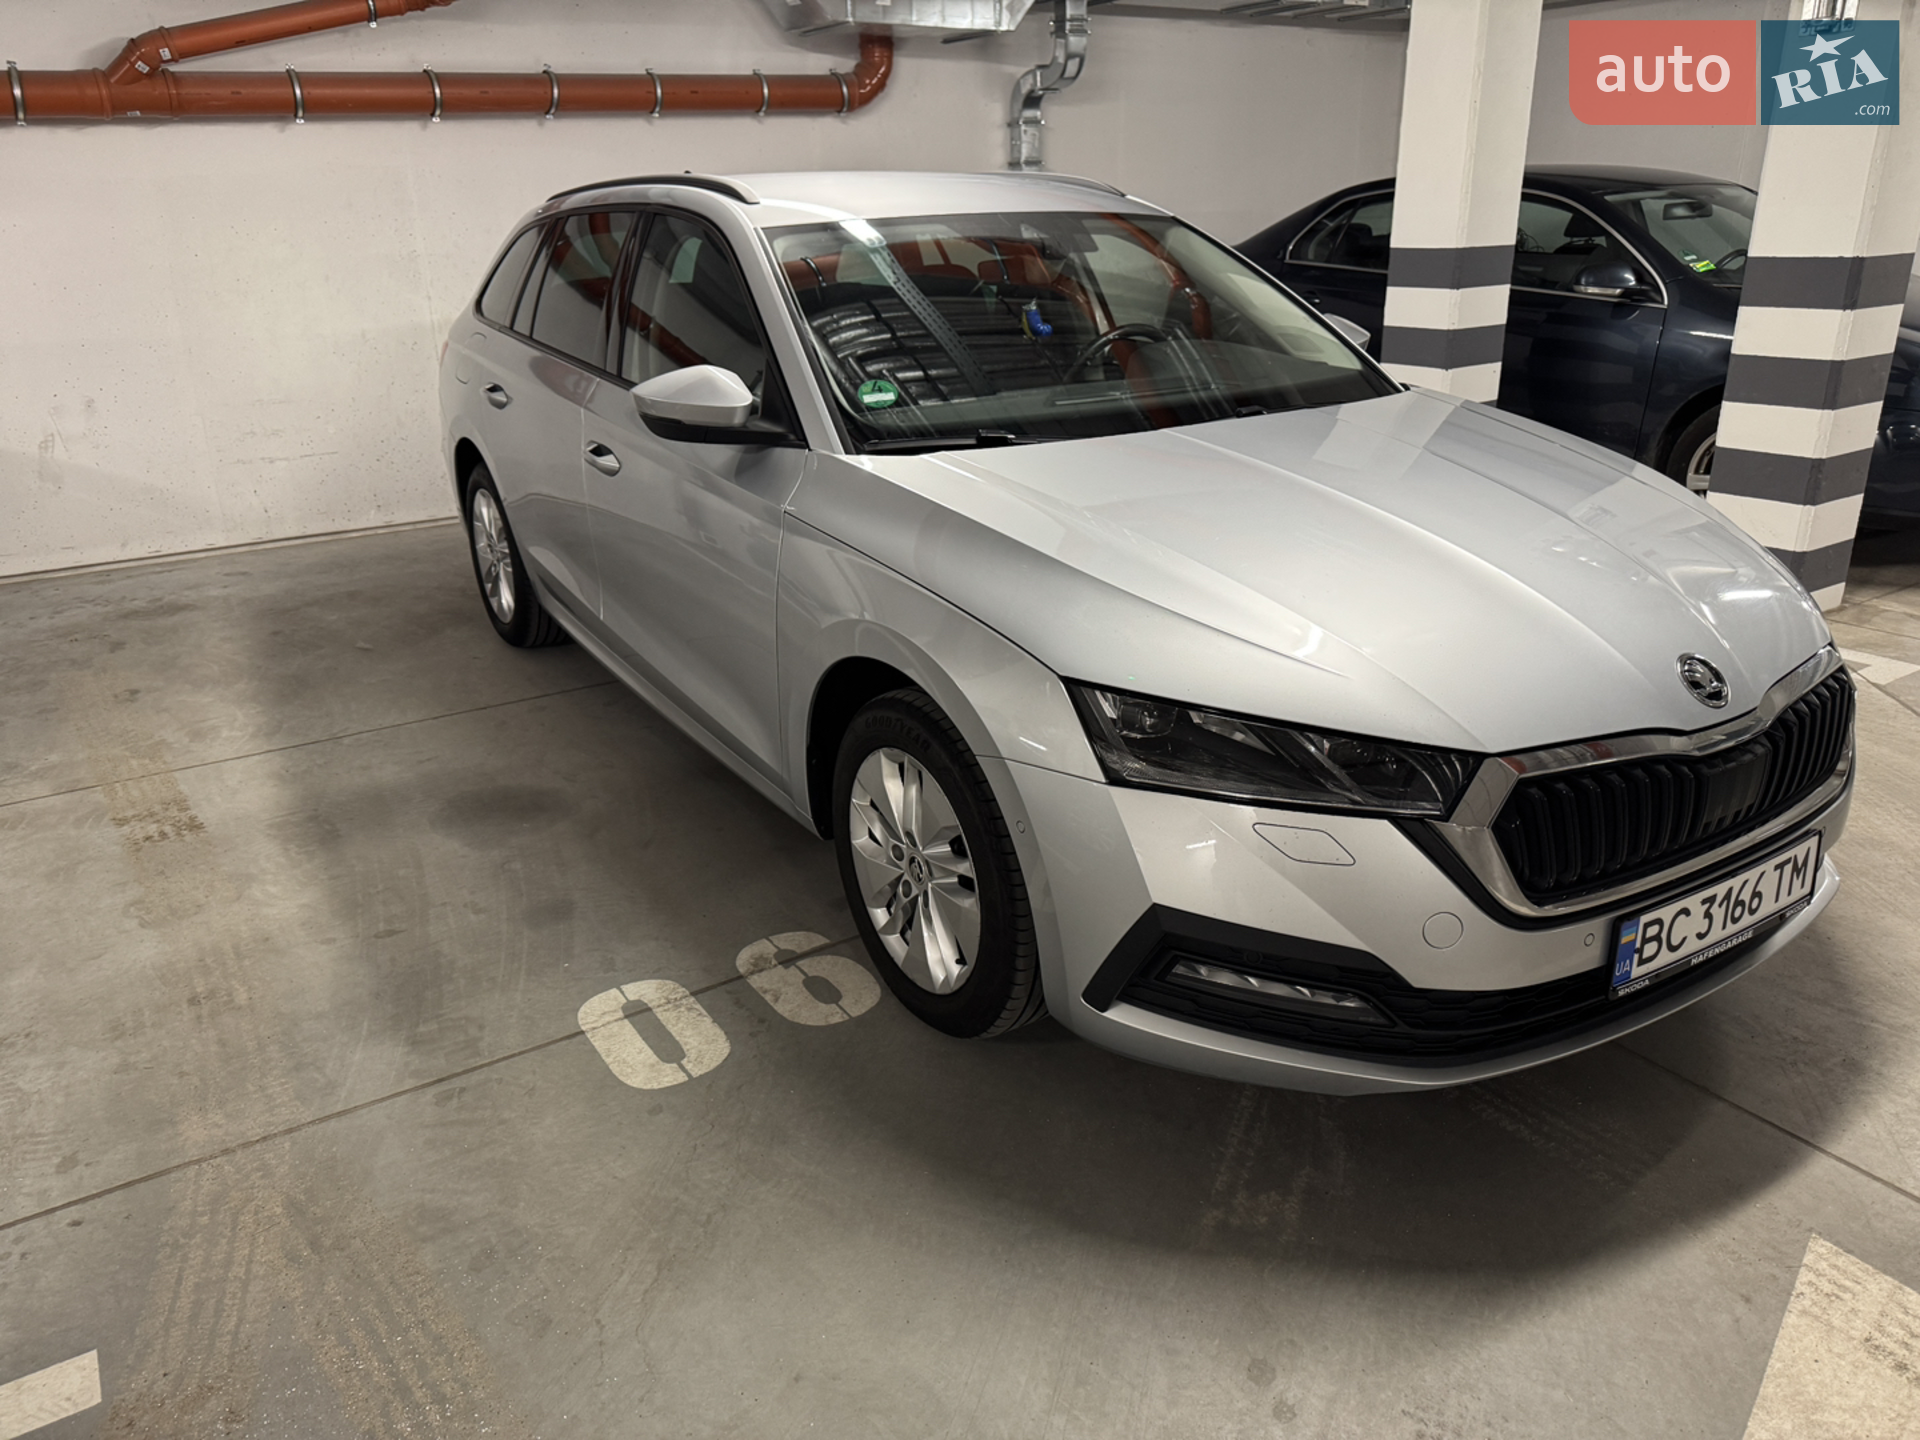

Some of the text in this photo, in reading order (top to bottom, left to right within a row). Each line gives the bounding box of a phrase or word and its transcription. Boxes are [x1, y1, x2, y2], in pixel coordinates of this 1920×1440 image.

[864, 715, 932, 753] GOODYEAR
[1637, 847, 1812, 968] BC 3166 TM
[1690, 929, 1755, 966] HAFENGARAGE
[1615, 959, 1630, 976] UA
